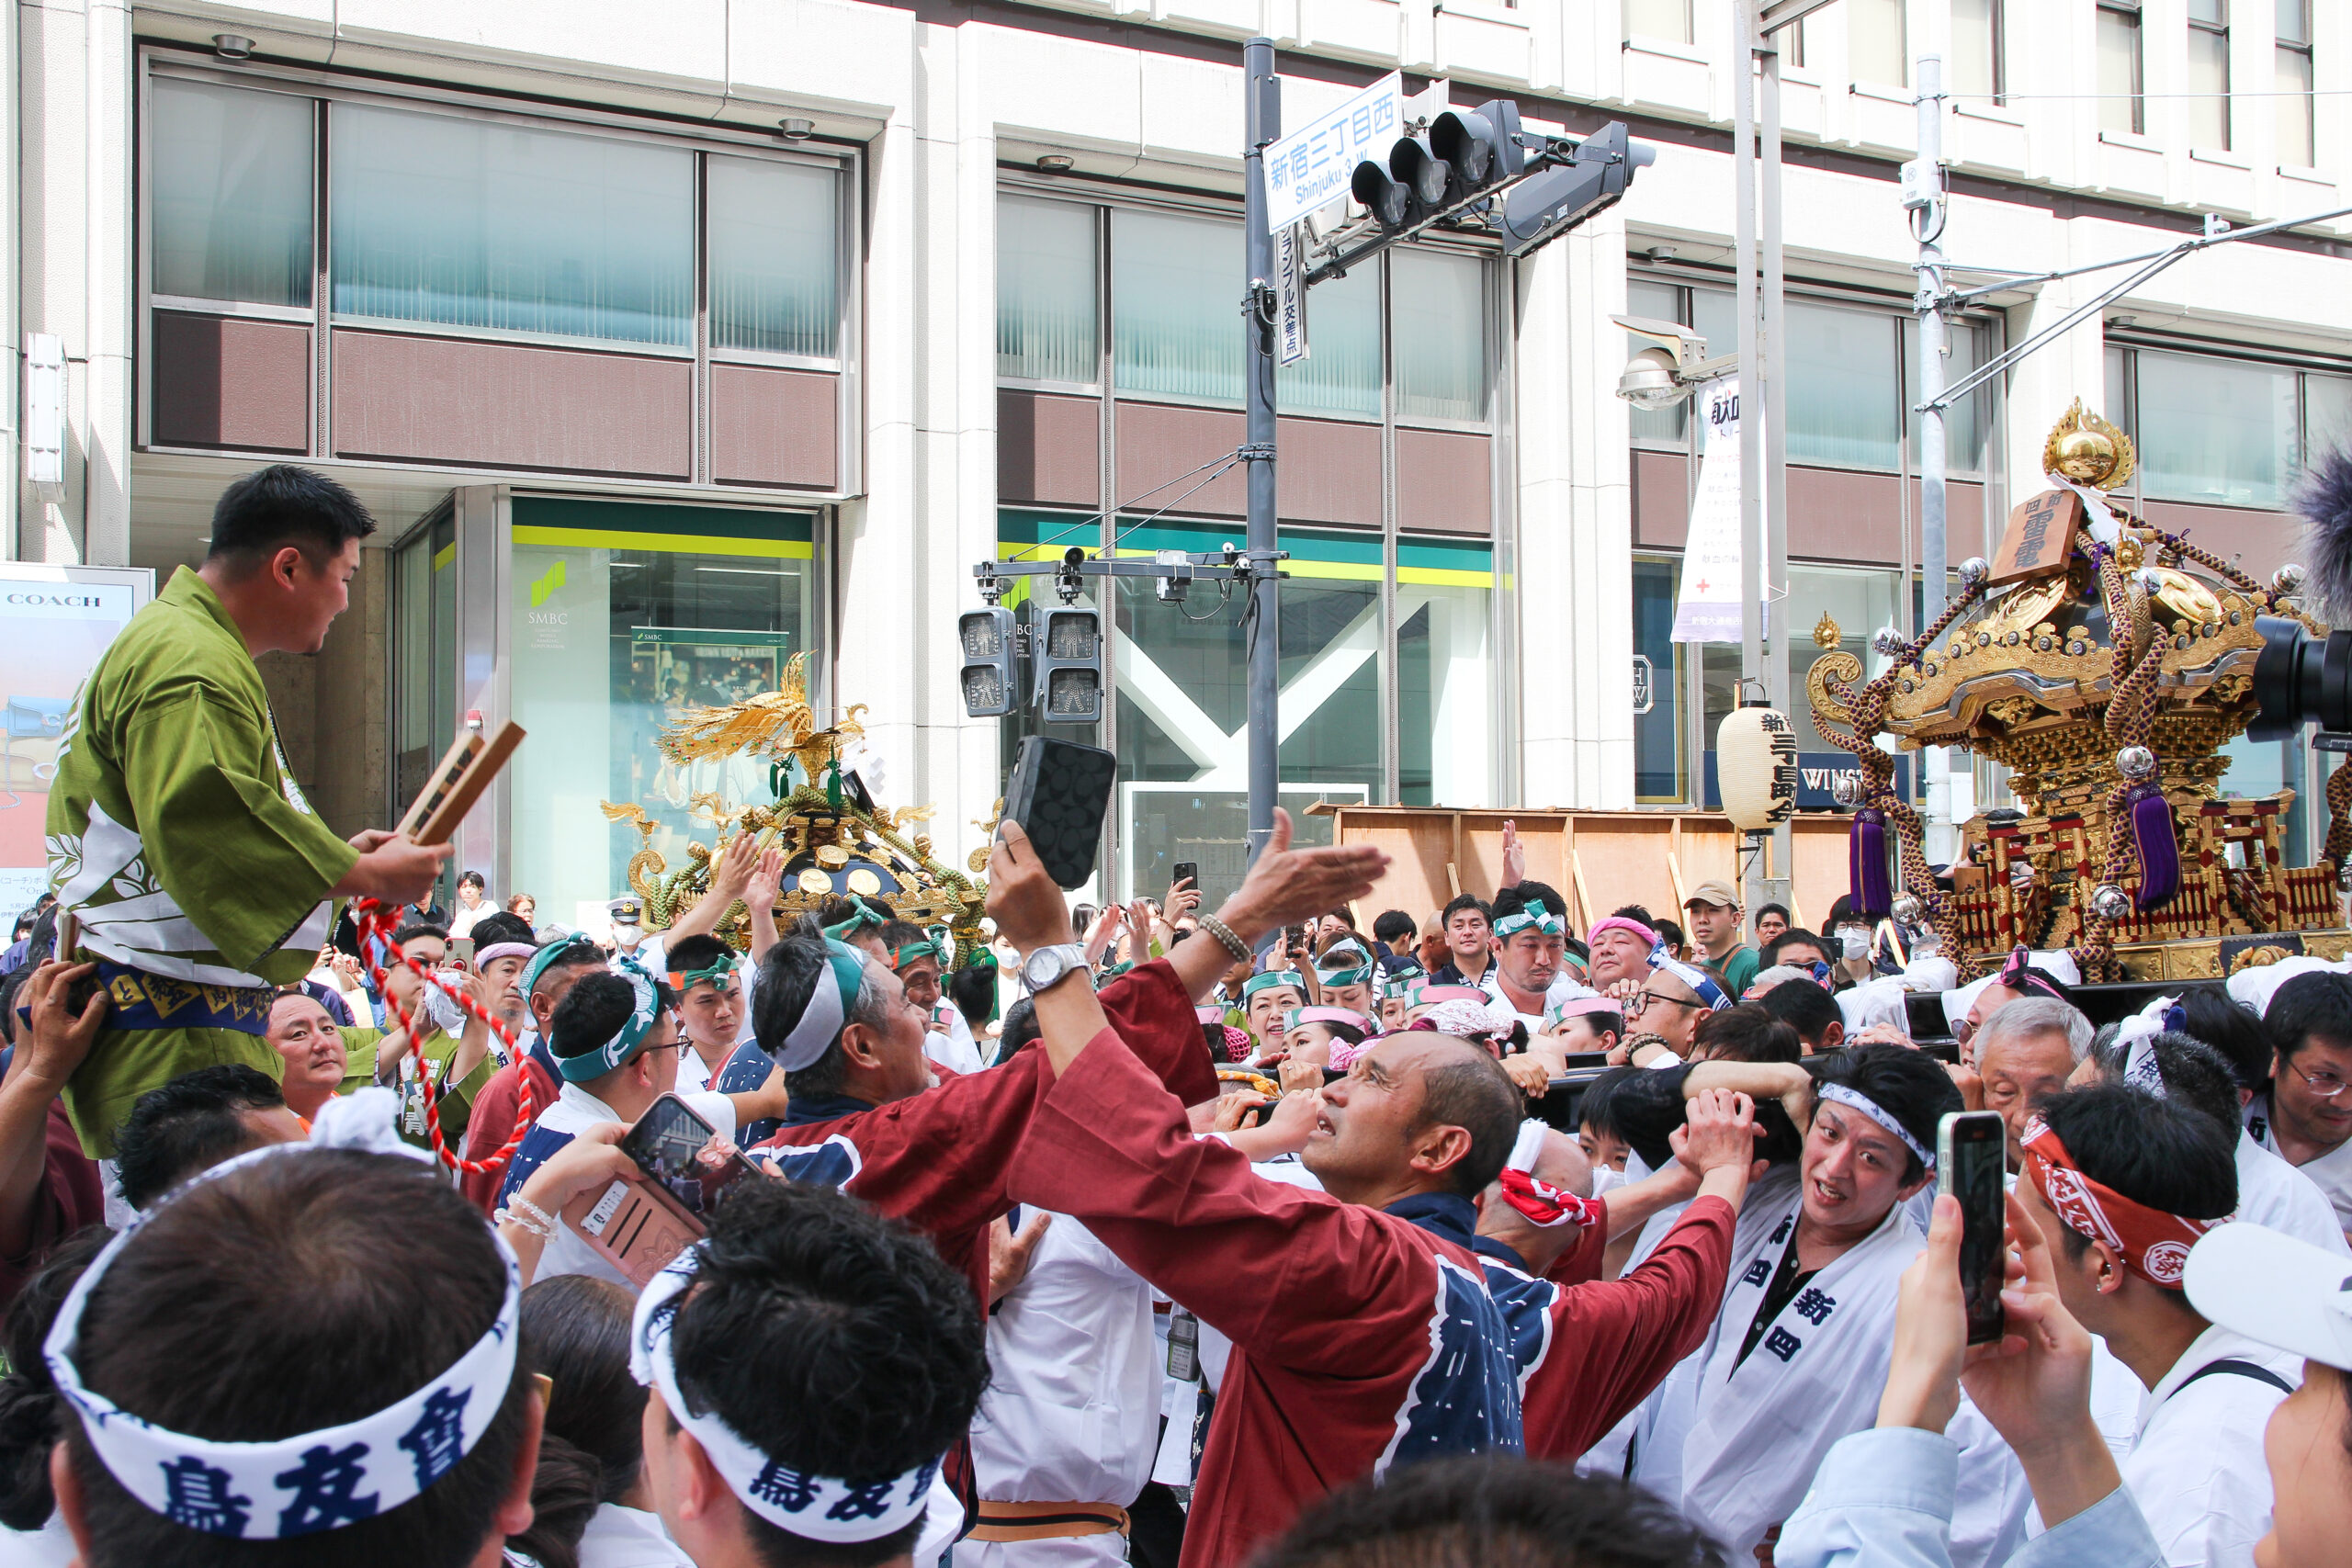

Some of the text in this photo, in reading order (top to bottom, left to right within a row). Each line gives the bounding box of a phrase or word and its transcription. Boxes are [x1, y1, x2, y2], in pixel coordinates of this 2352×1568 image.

[1271, 92, 1394, 191] 新宿三丁目西
[1295, 169, 1342, 205] Shinjuku
[1345, 158, 1352, 177] 3
[7, 593, 103, 607] COACH
[528, 612, 568, 626] SMBC
[1016, 624, 1033, 636] BC
[1765, 1288, 1837, 1362] 新四
